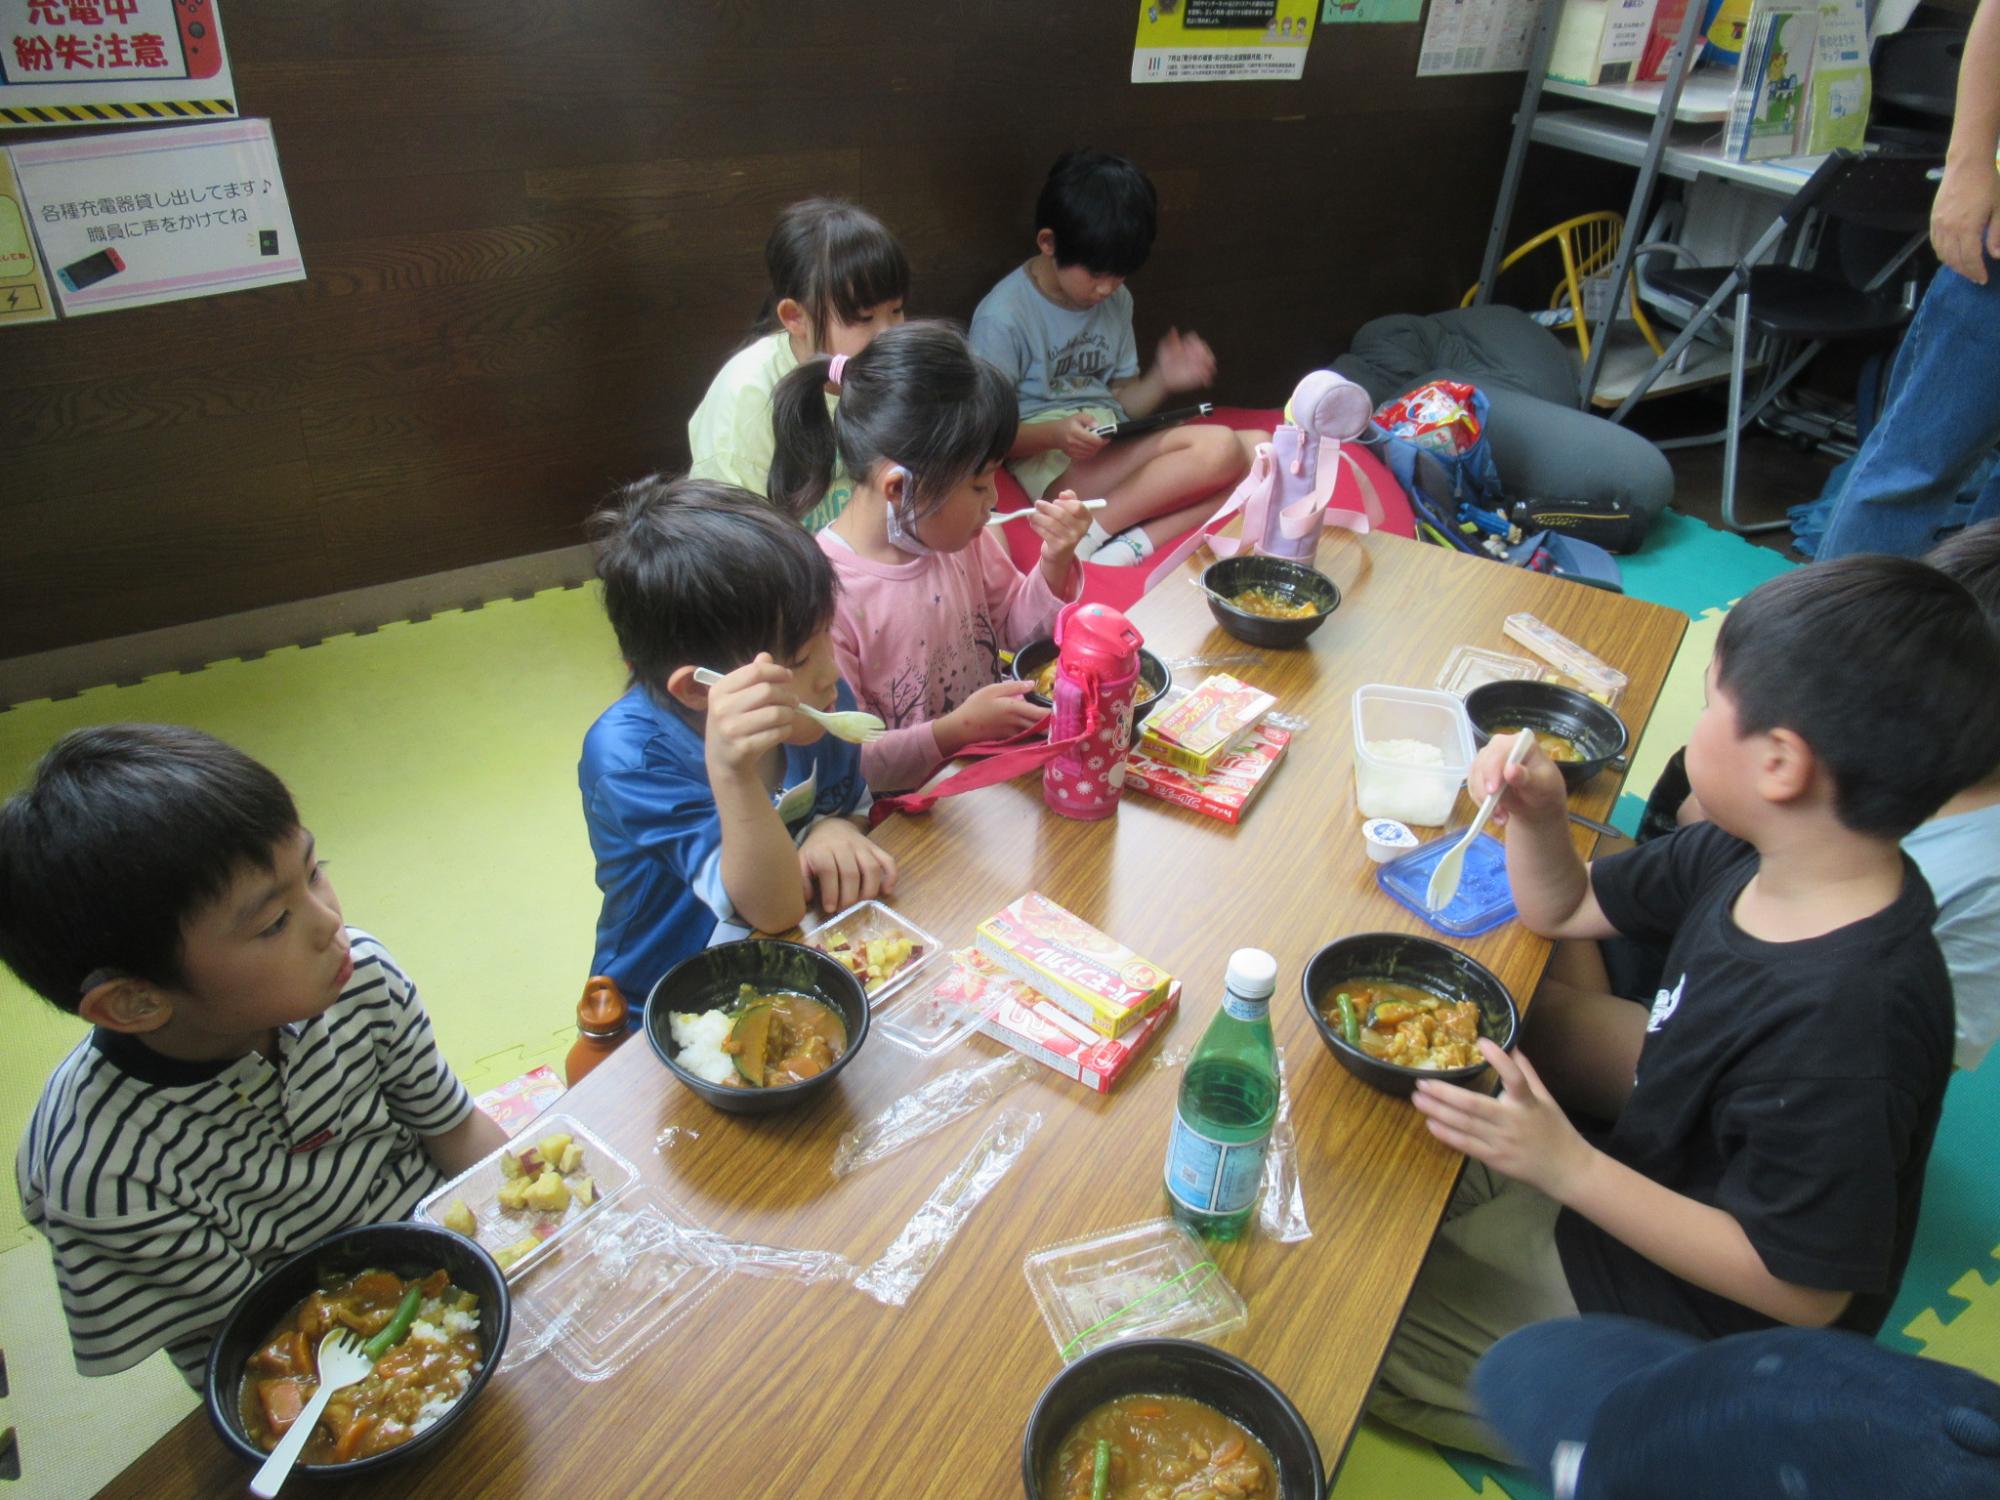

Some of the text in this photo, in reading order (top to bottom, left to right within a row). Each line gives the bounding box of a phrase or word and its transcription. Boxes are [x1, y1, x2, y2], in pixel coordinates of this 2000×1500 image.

[27, 0, 139, 26] 充電中
[13, 33, 169, 71] 紛失注意
[87, 208, 248, 243] 職員に声をかけてね
[1021, 943, 1142, 1003] バーモントカレー
